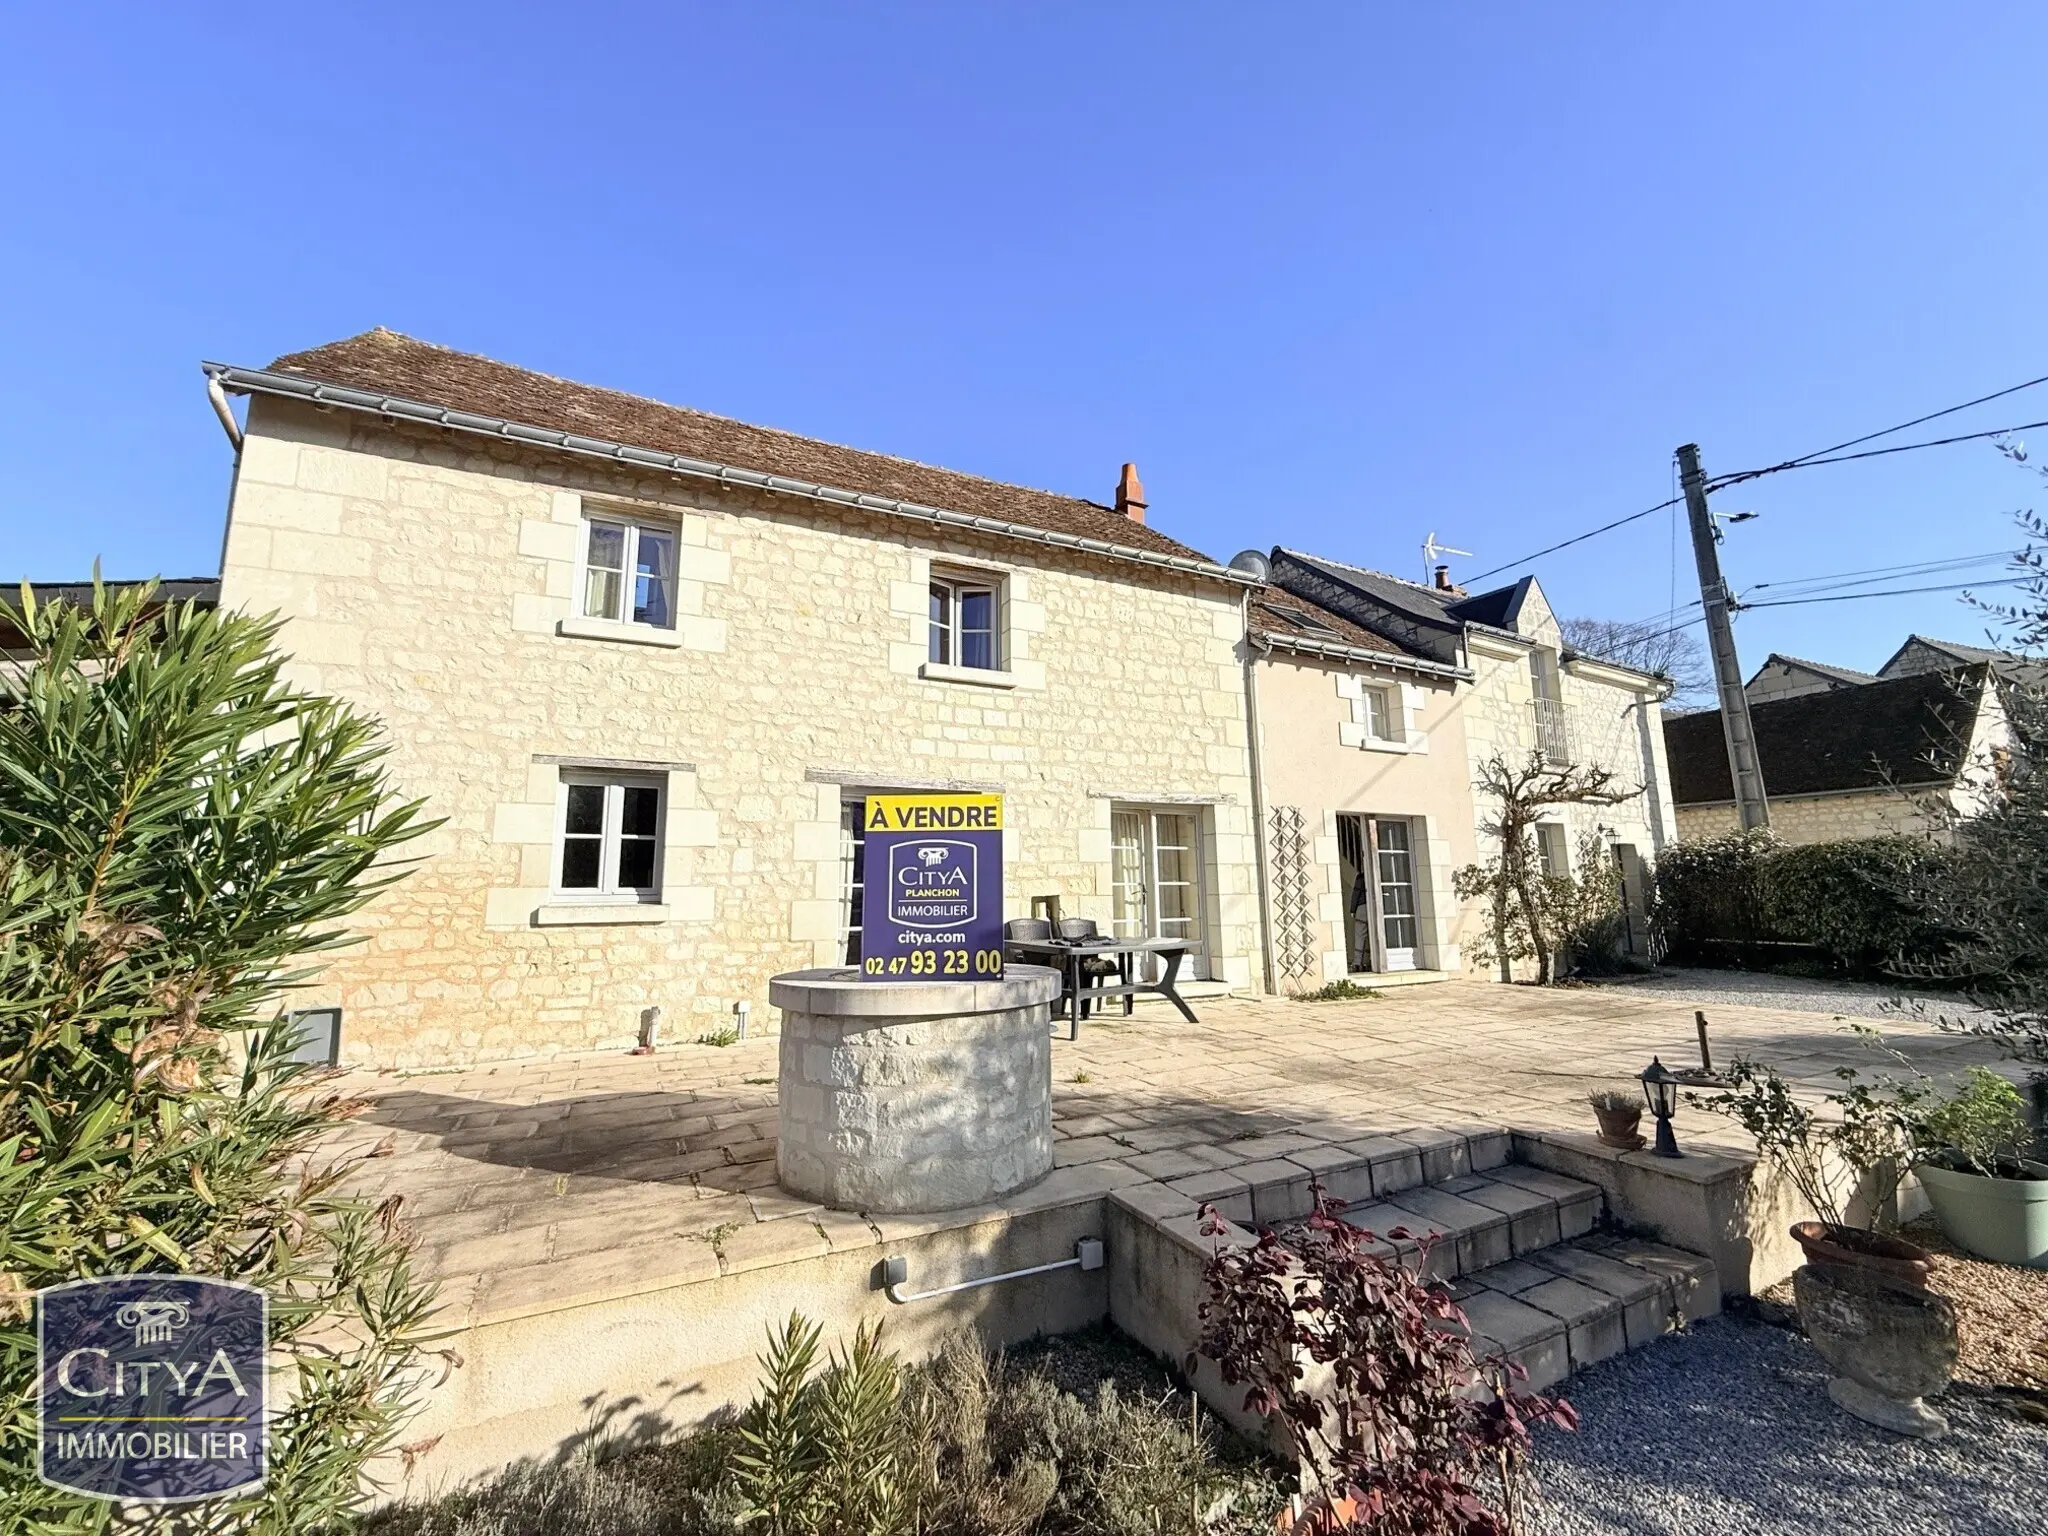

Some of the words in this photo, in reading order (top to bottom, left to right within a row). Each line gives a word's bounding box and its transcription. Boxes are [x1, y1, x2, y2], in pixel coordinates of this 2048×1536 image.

[869, 801, 889, 828] À
[895, 806, 997, 828] VENDRE
[905, 888, 960, 897] PLANCHON
[898, 905, 968, 916] IMMOBILIER
[898, 930, 966, 946] citya.com
[865, 957, 884, 975] 02
[888, 957, 907, 974] 47
[910, 950, 937, 975] 93
[943, 950, 969, 974] 23
[975, 949, 1001, 974] 00
